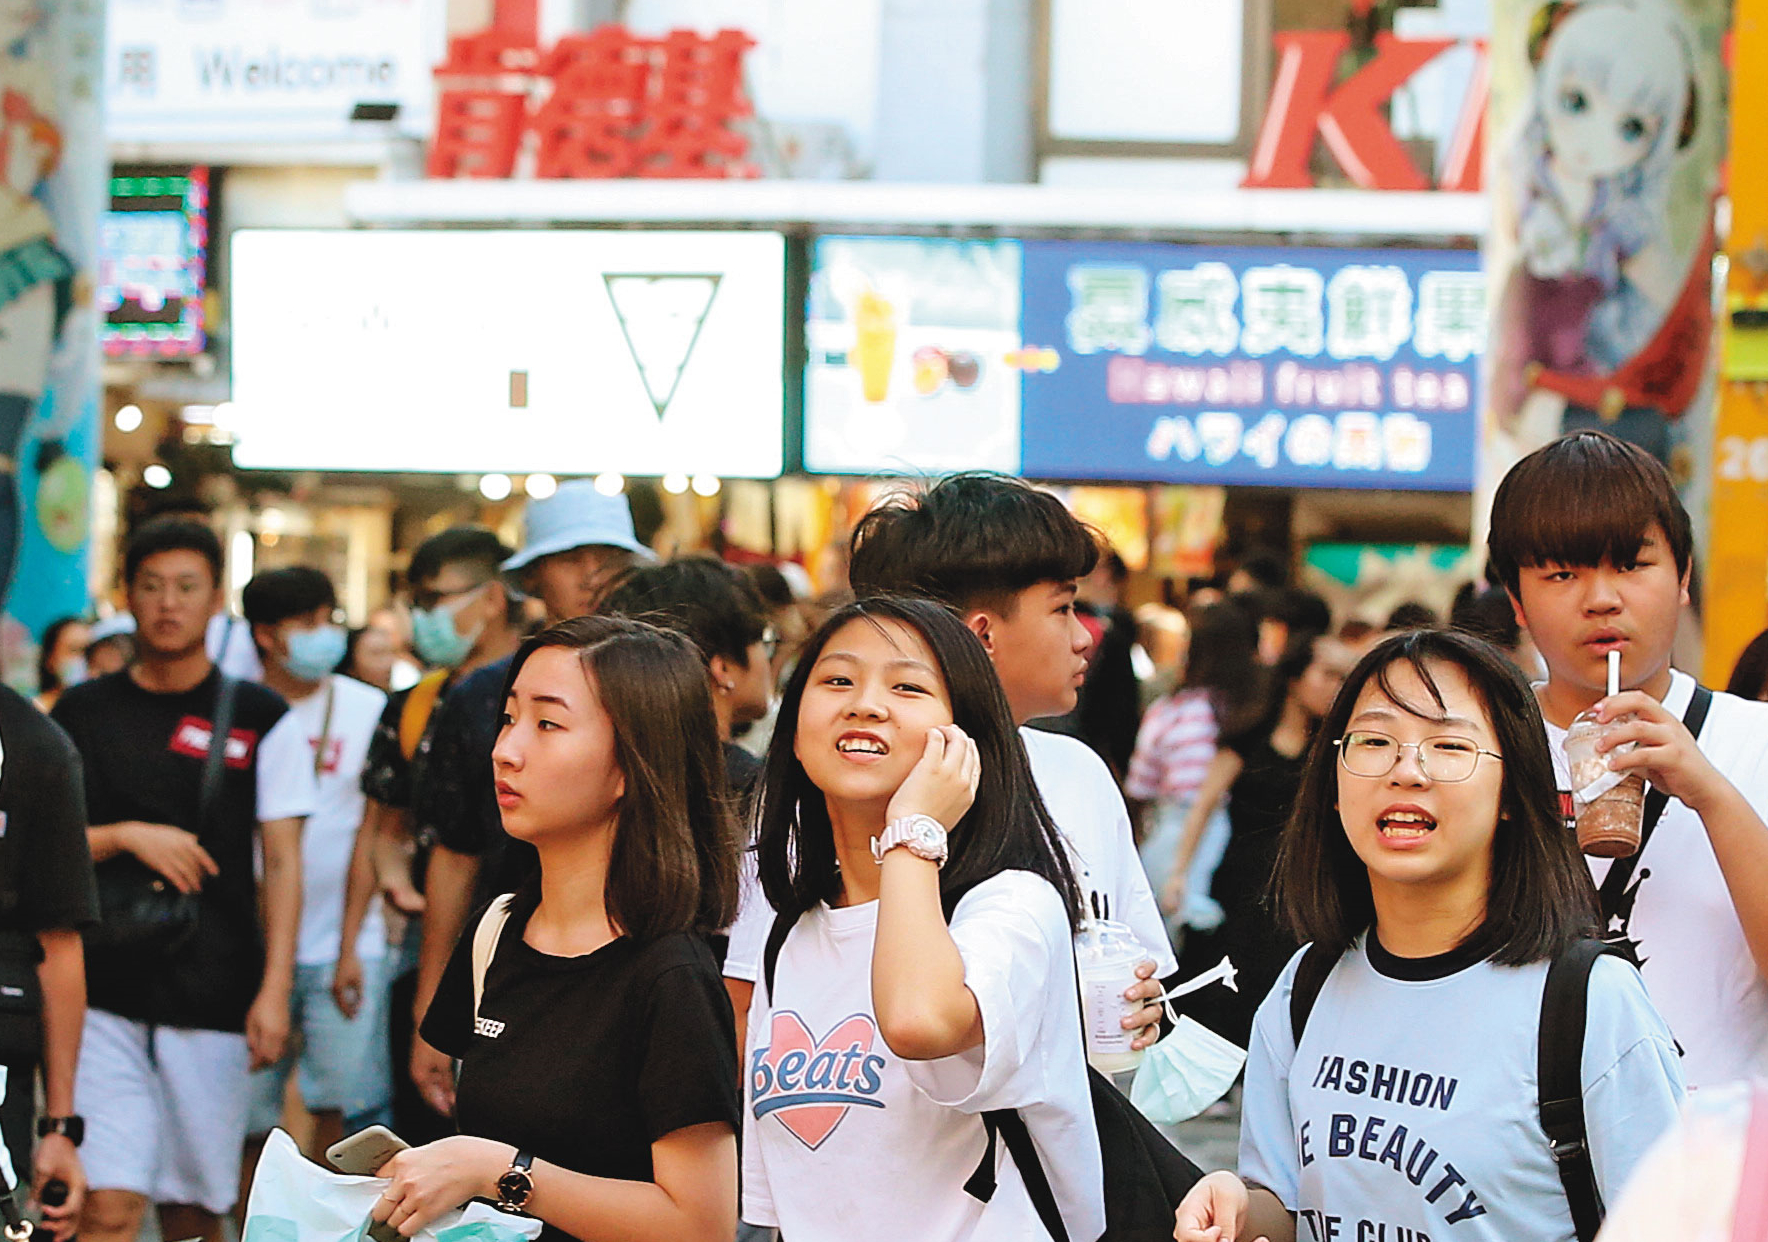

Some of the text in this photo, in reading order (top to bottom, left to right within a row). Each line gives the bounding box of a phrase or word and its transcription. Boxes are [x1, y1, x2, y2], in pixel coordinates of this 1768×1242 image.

[192, 44, 398, 92] Welcome
[1275, 360, 1382, 407] fruit
[1392, 364, 1469, 411] tea
[752, 1044, 886, 1100] beats
[1329, 1113, 1487, 1225] BEAUTY
